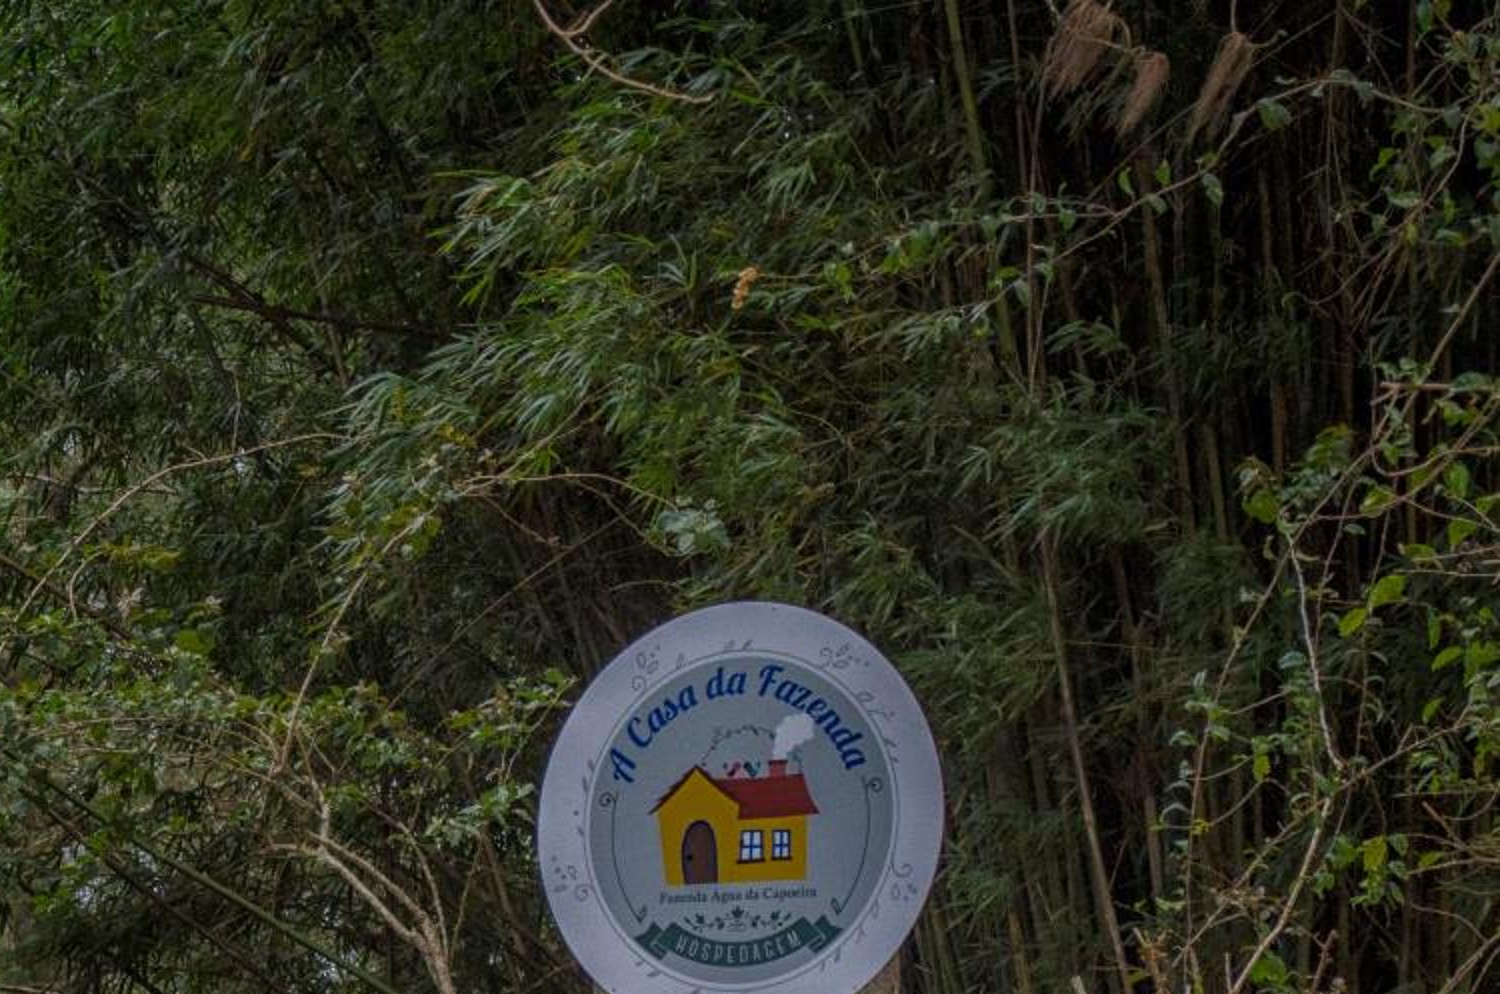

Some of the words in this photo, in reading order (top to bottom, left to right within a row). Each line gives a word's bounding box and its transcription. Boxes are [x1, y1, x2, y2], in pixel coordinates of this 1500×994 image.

[610, 747, 636, 783] A
[627, 685, 699, 749] Casa
[706, 667, 747, 699] da
[758, 664, 868, 770] Fazenda
[674, 930, 801, 965] HOSPEDAGEM
